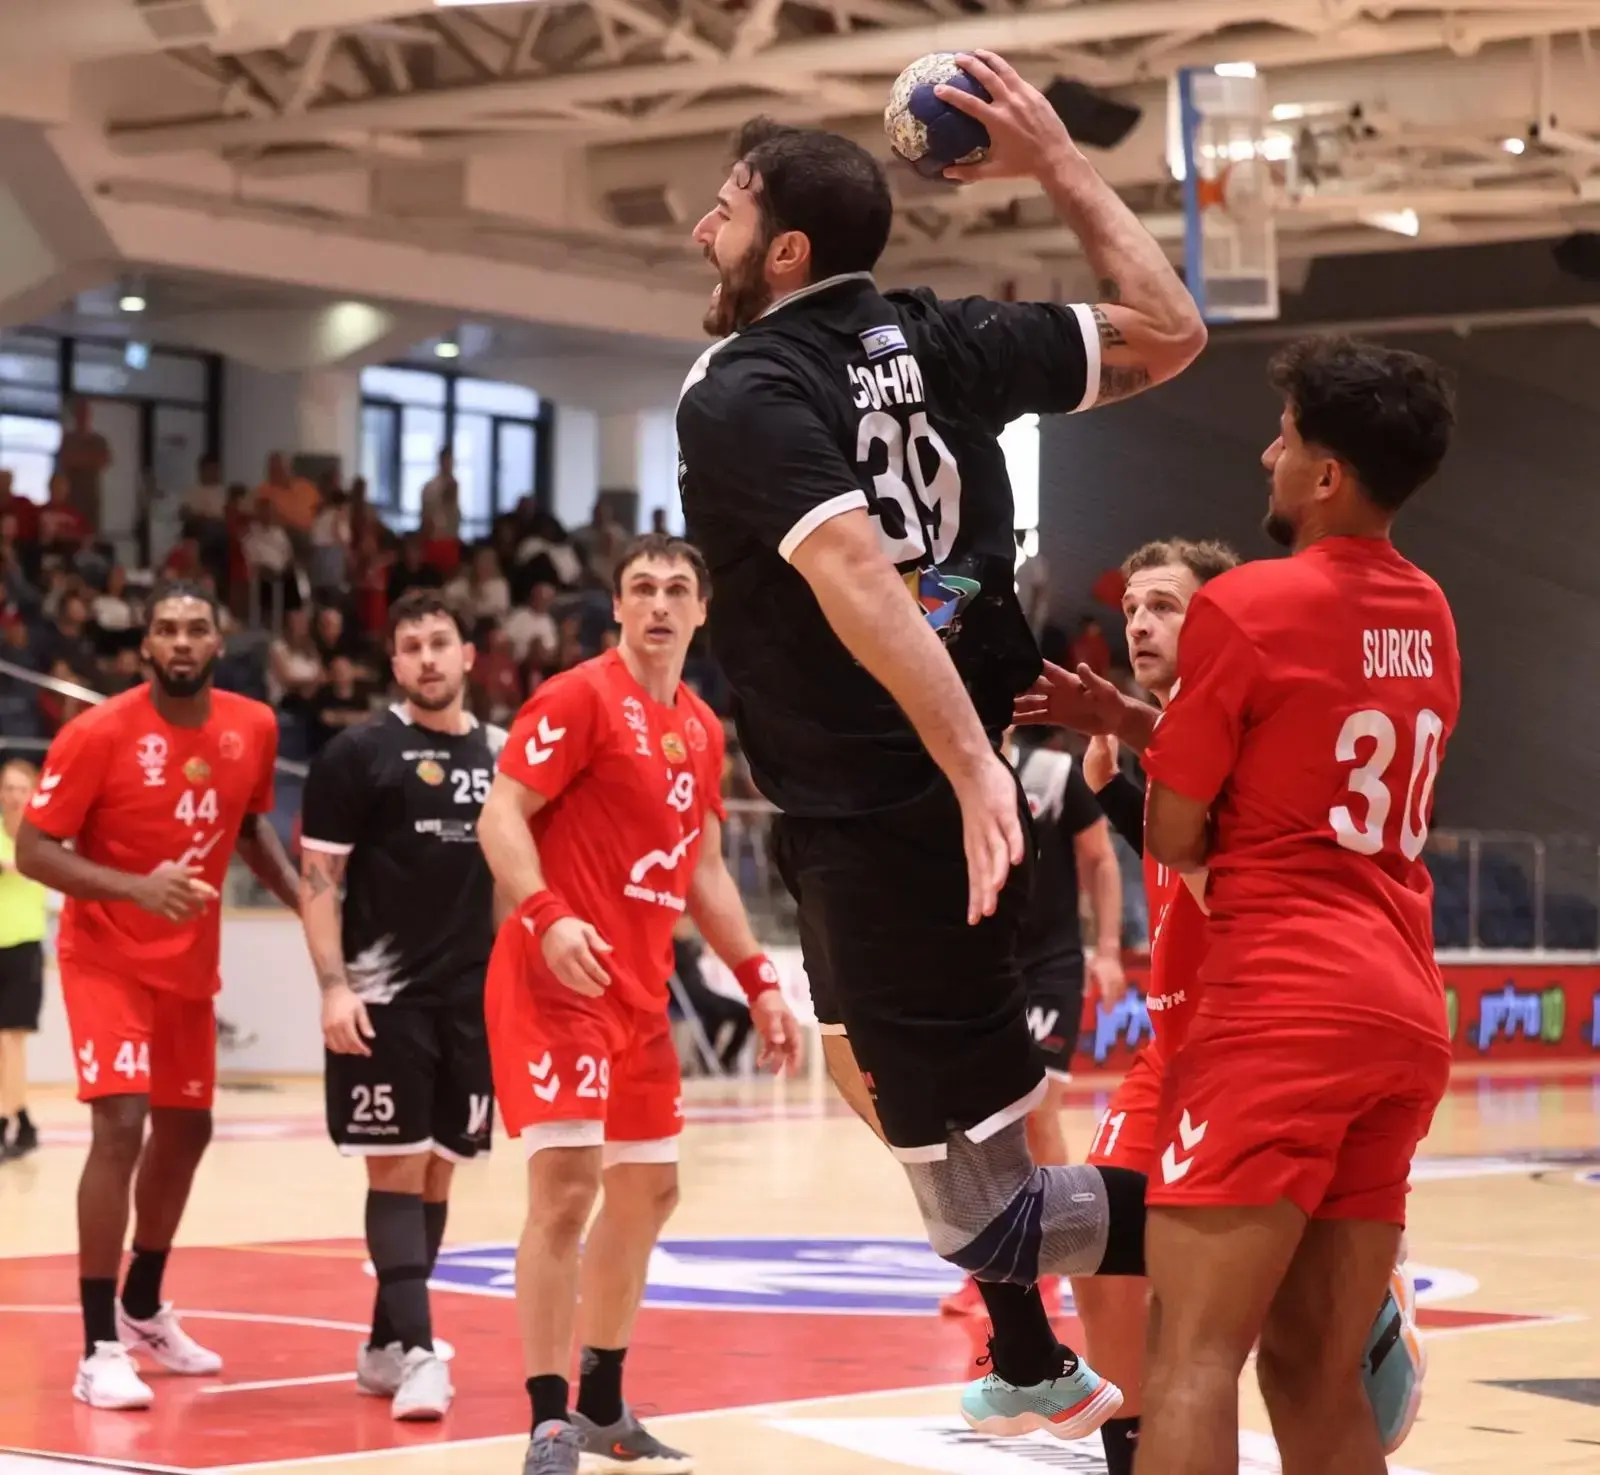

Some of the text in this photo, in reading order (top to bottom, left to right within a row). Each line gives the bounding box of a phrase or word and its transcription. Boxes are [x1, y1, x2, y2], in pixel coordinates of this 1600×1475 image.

[856, 411, 962, 565] 39
[1362, 629, 1434, 679] SURKIS
[174, 788, 219, 827] 44
[450, 767, 492, 804] 25
[1329, 708, 1443, 862] 30
[575, 1054, 610, 1101] 29
[351, 1083, 395, 1122] 25
